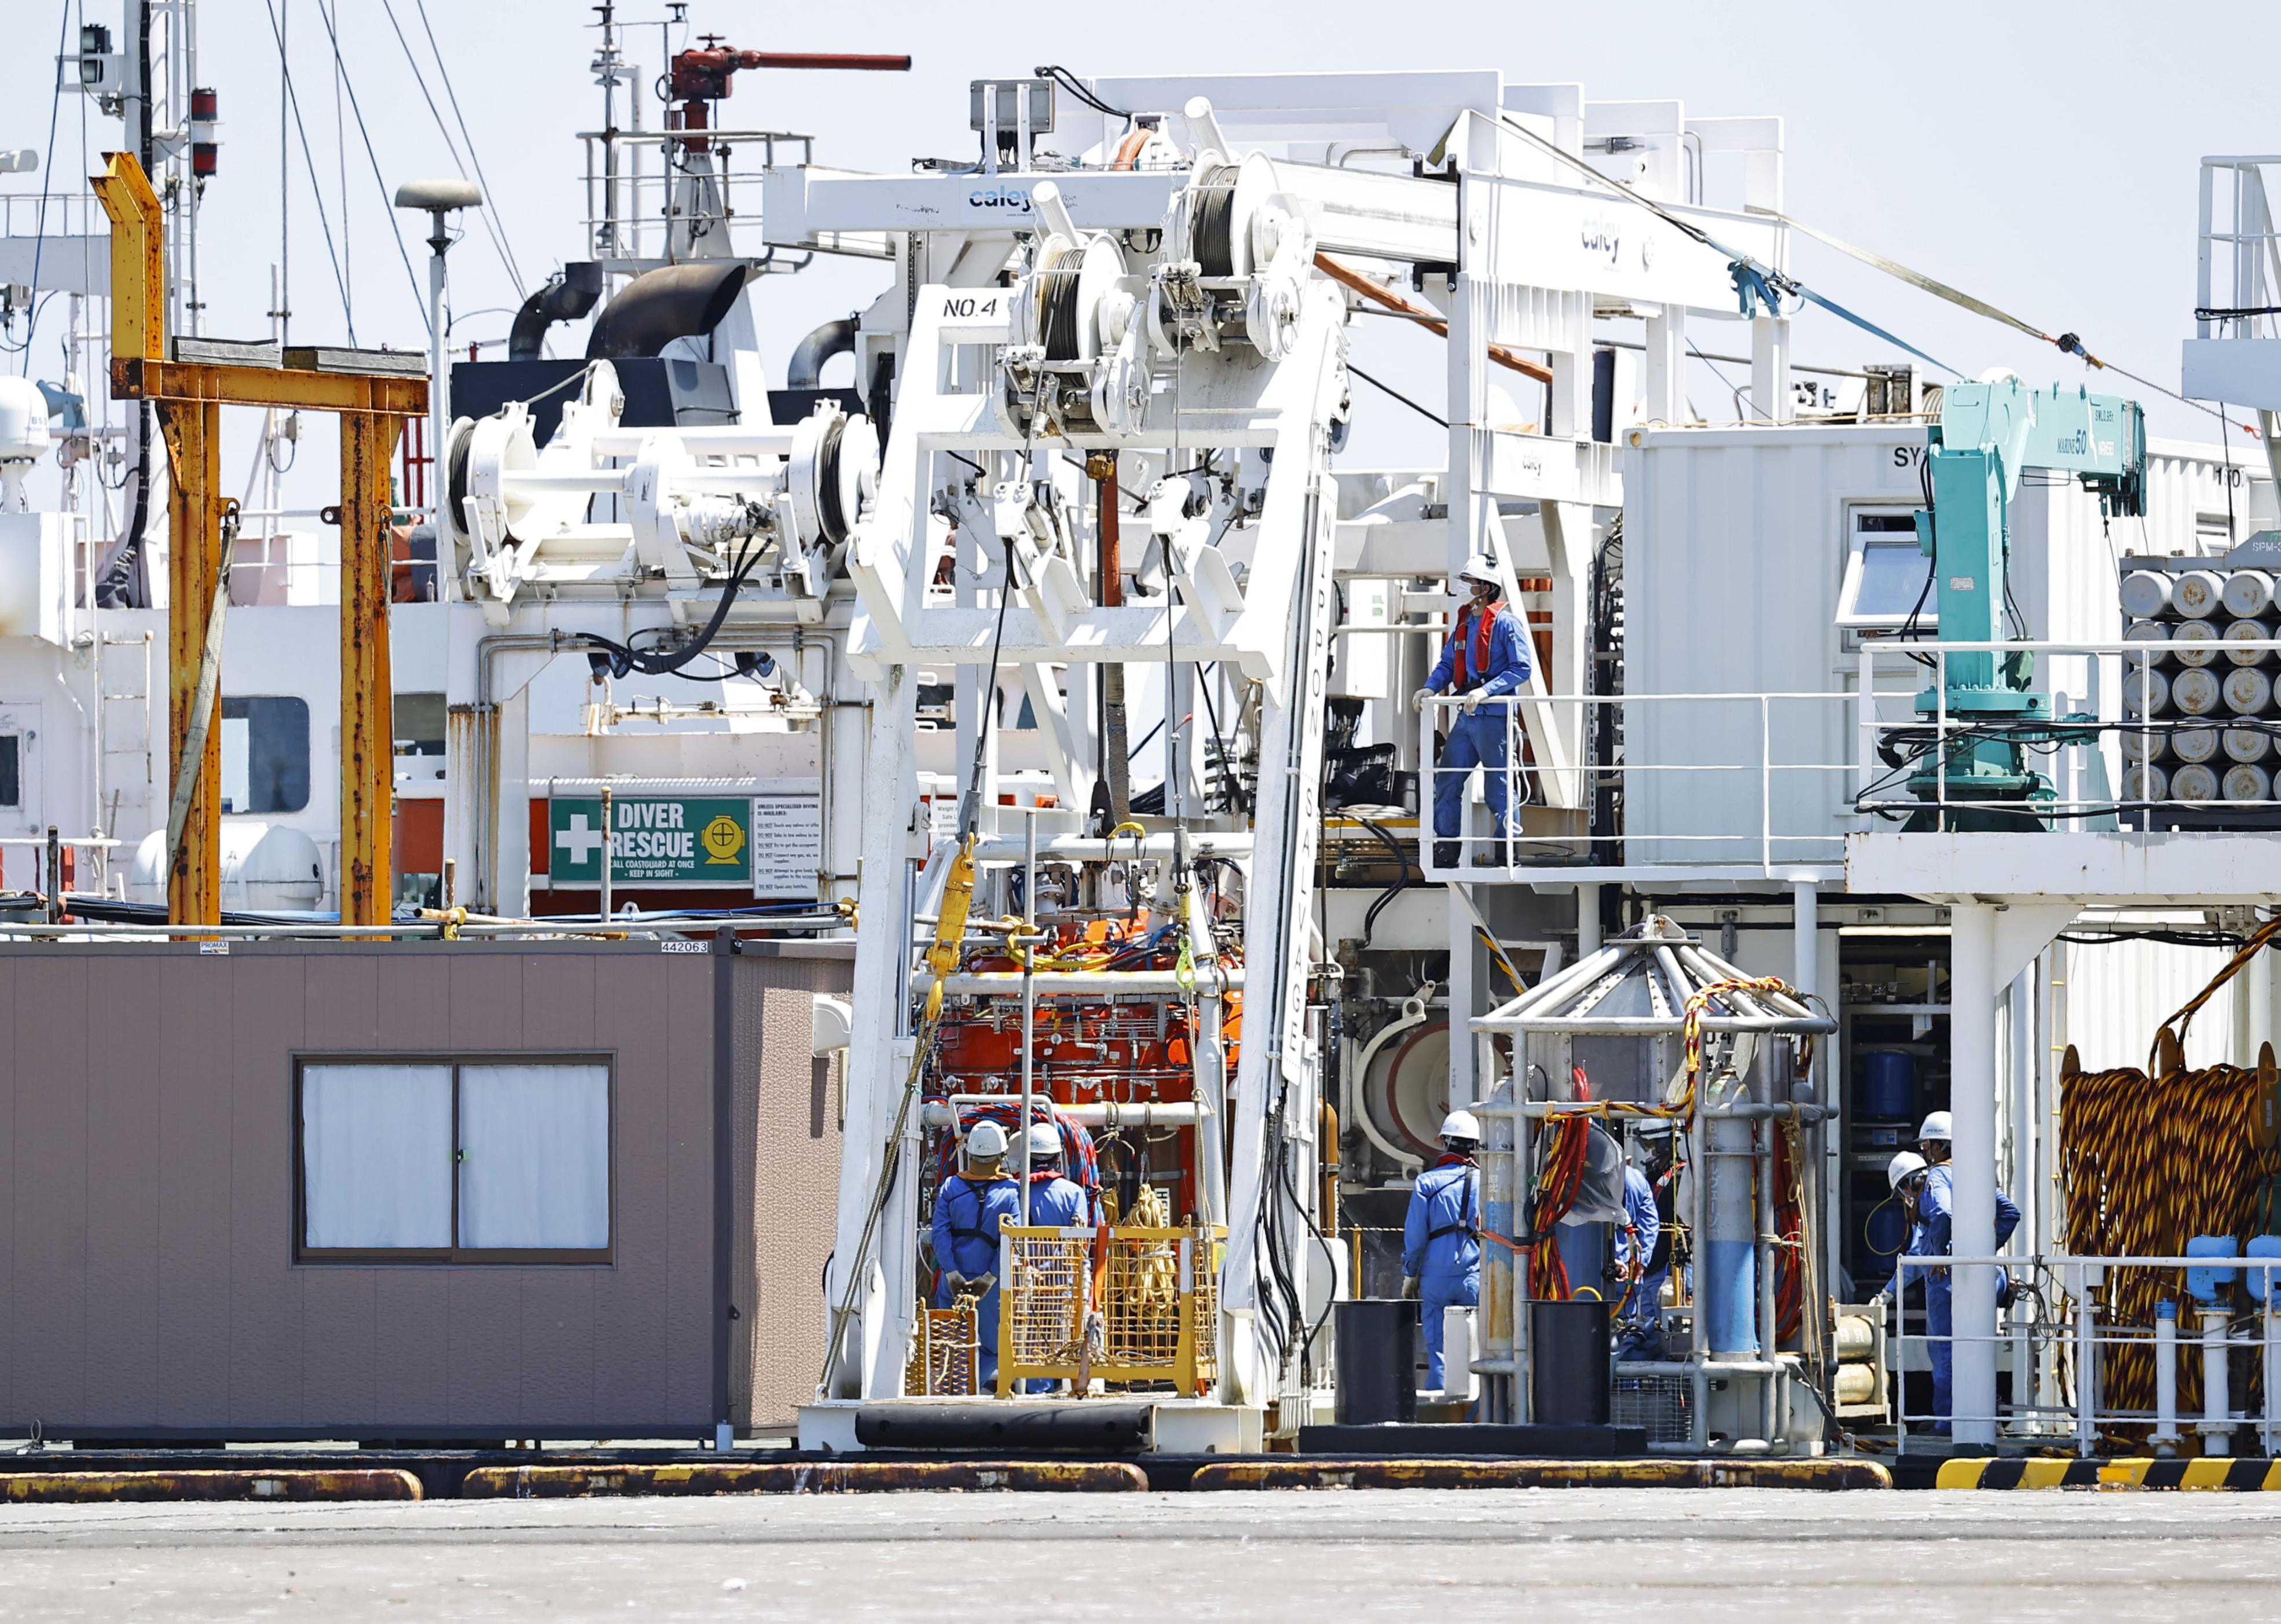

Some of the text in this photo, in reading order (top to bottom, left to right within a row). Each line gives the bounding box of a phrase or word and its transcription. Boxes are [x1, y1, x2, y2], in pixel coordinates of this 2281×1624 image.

[969, 185, 1031, 212] caley
[1582, 210, 1620, 264] caley
[943, 299, 997, 317] NO.4
[1894, 447, 1921, 468] SY
[618, 803, 684, 828] DIVER
[610, 832, 694, 857] RESCUE
[625, 860, 666, 868] COASTGUARD
[678, 860, 694, 868] ONCE
[662, 942, 707, 951] 442063
